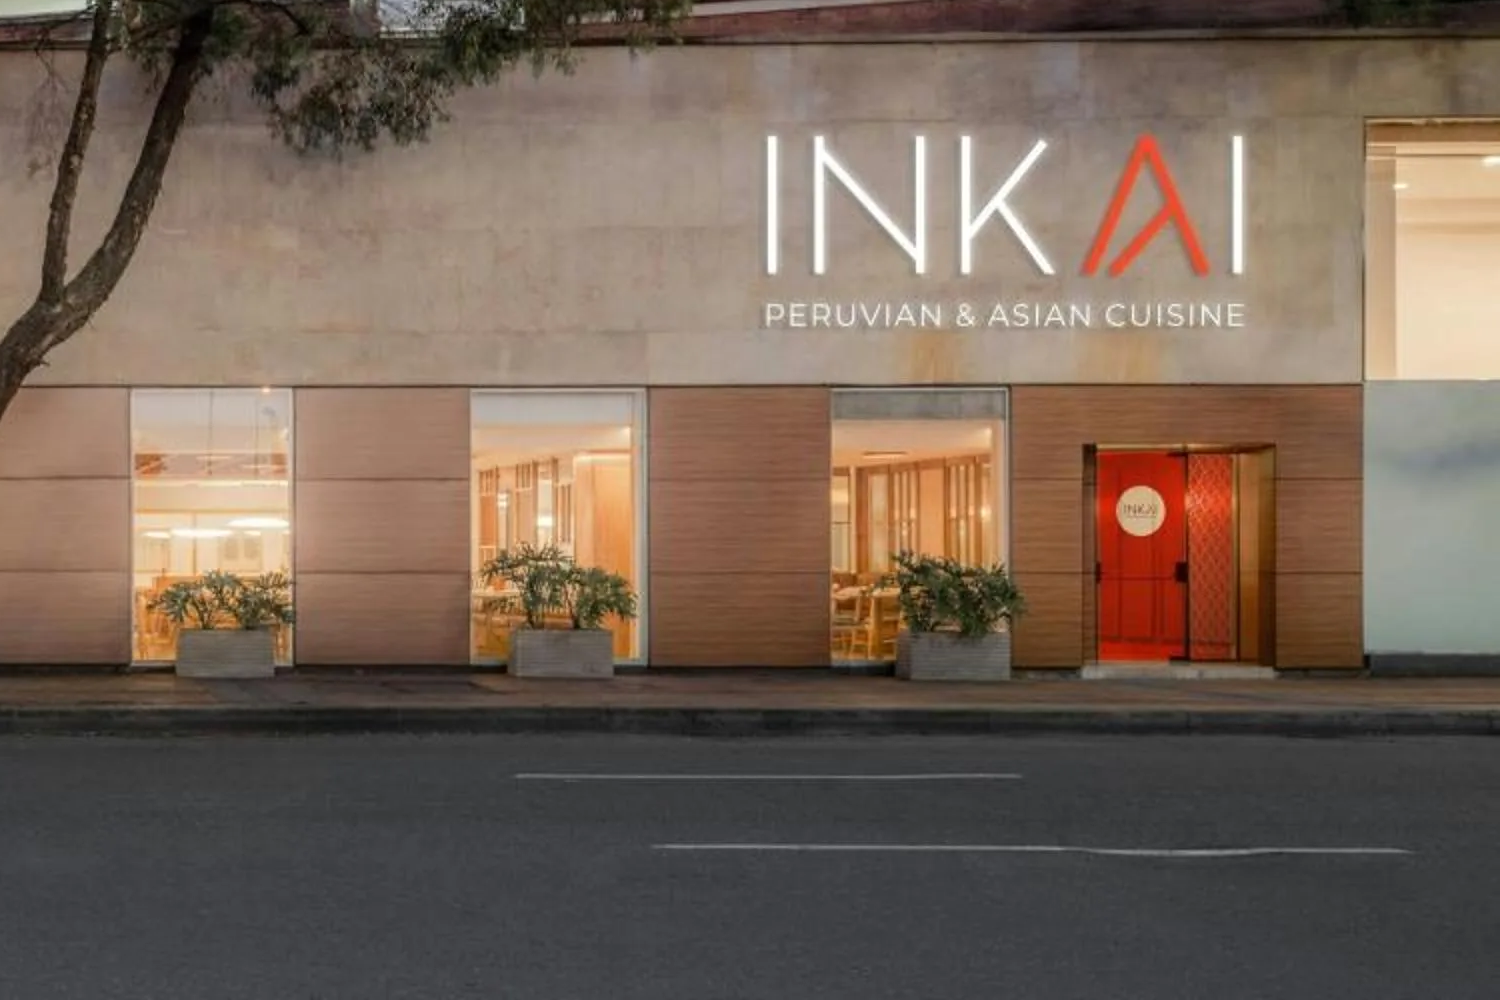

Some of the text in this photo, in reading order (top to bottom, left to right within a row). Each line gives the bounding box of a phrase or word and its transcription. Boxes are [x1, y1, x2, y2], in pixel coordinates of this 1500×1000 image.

[766, 133, 1244, 277] INKAI
[765, 303, 1245, 328] PERUVIAN & ASIAN CUISINE
